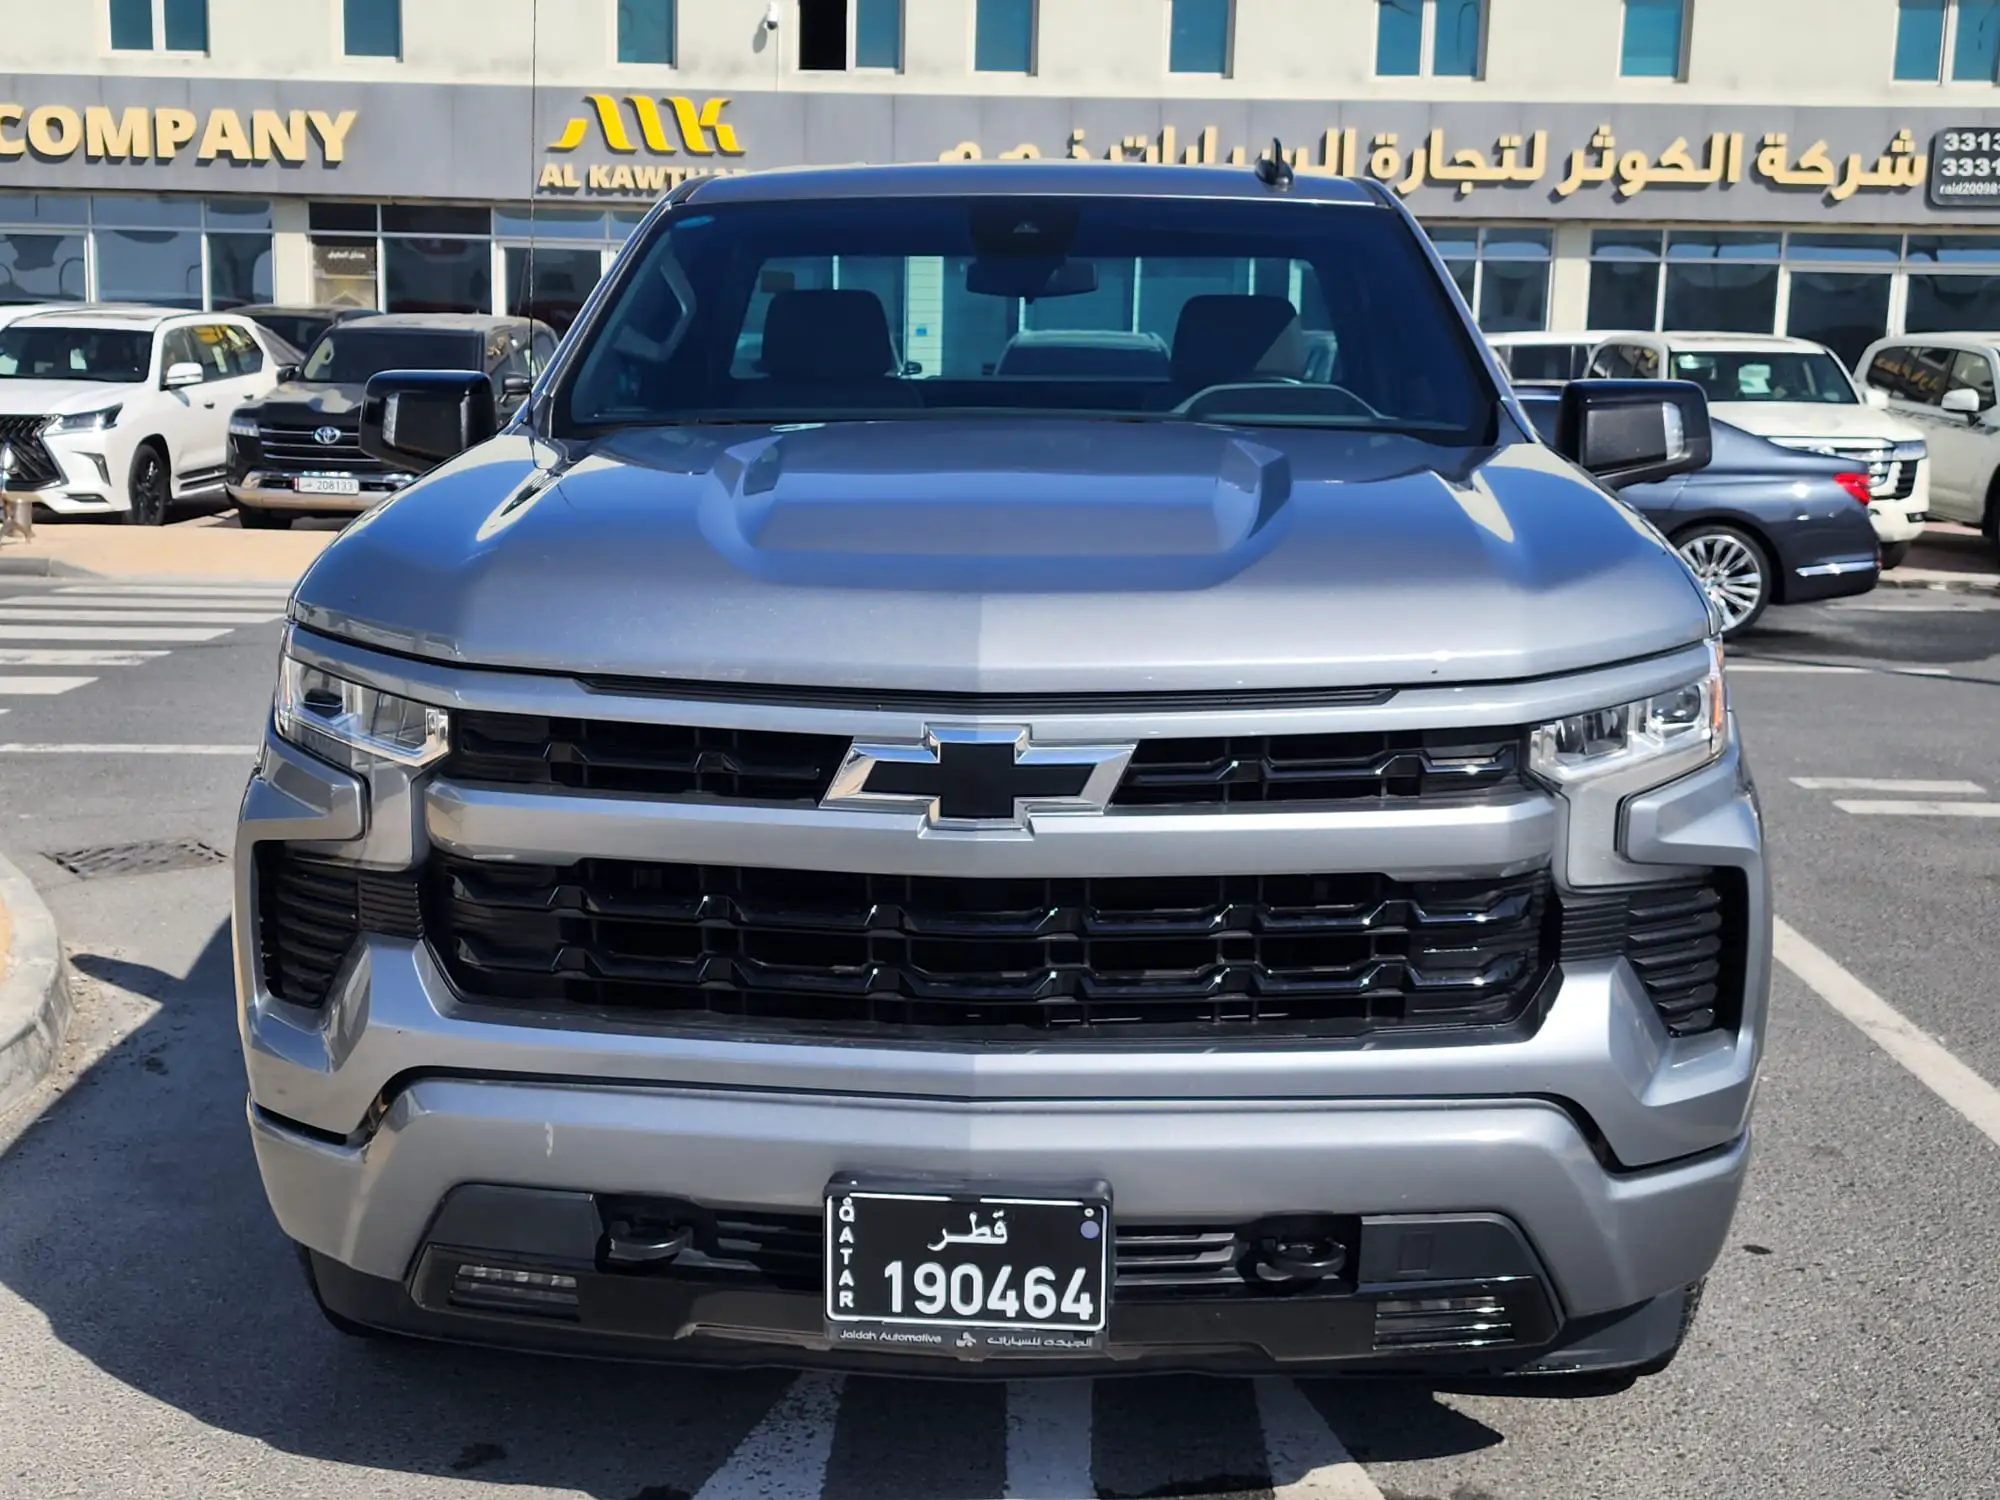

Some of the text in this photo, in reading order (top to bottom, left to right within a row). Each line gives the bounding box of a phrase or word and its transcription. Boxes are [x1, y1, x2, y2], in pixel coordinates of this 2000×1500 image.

[0, 104, 356, 163] COMPANY
[1370, 129, 1547, 196] لتجارة
[1556, 125, 1742, 197] الكوثر
[539, 164, 747, 189] AL KAWT
[1757, 129, 1927, 200] شركة
[838, 1205, 855, 1308] QATAR
[927, 1210, 1008, 1251] قطر
[884, 1261, 1094, 1320] 190464
[840, 1329, 942, 1344] Jaidah Automotive
